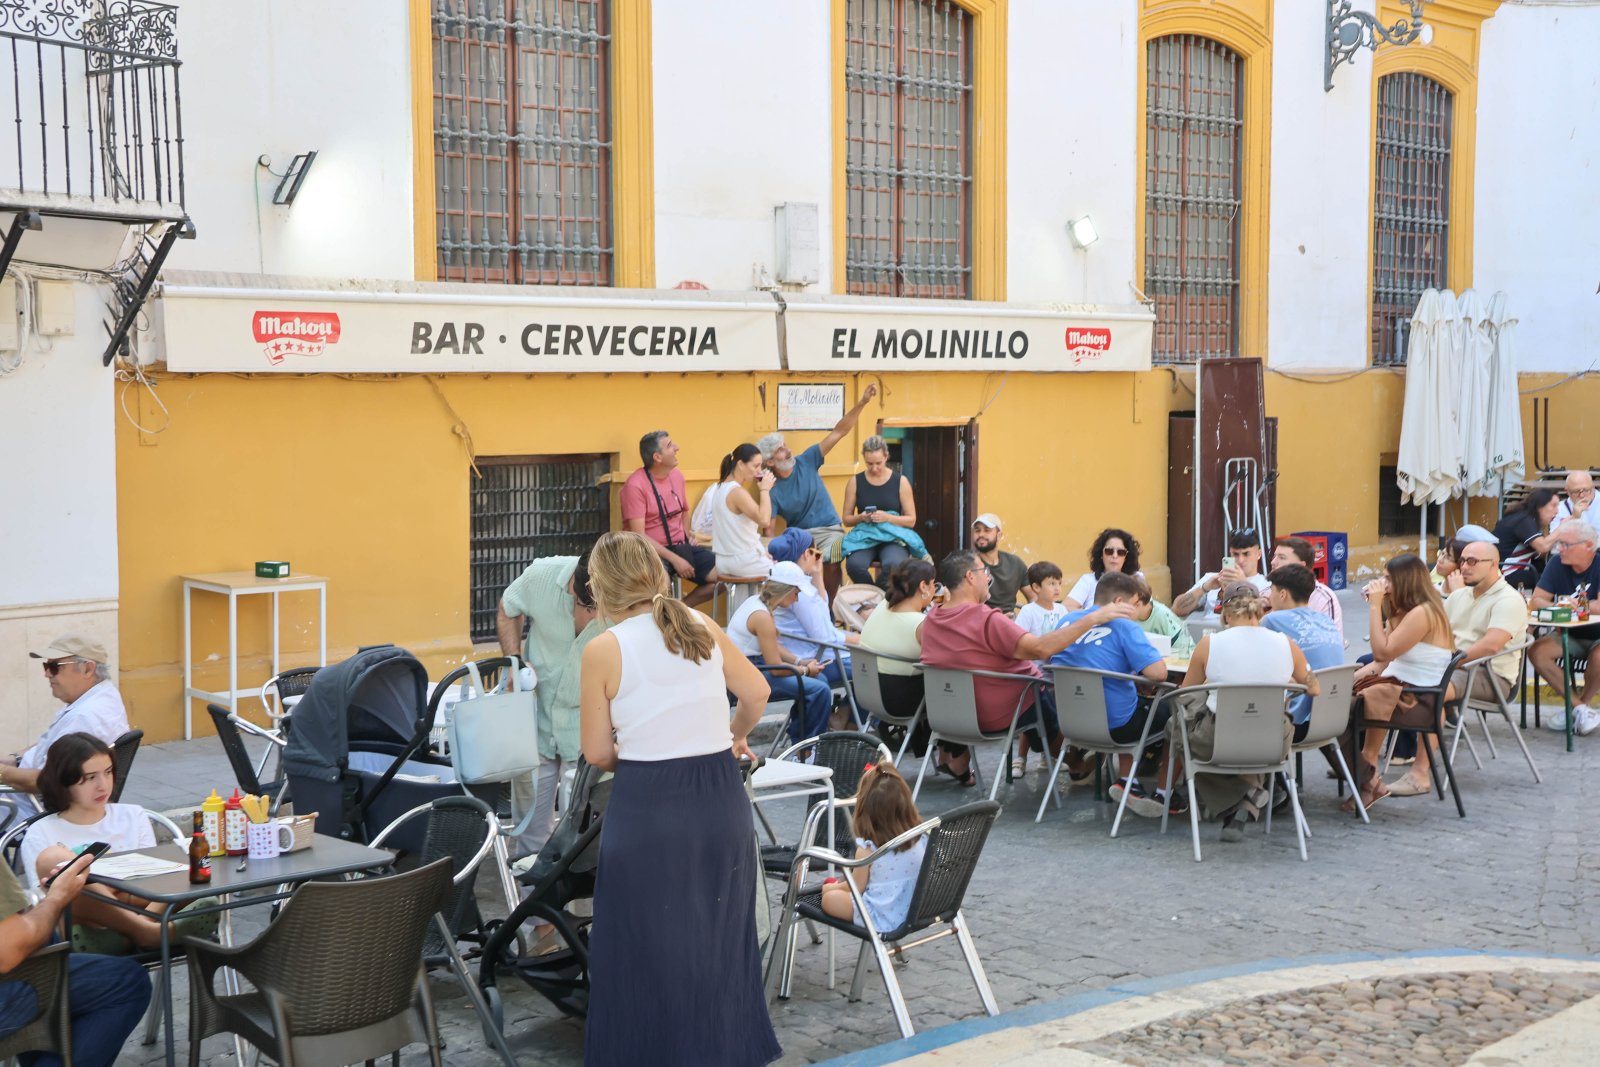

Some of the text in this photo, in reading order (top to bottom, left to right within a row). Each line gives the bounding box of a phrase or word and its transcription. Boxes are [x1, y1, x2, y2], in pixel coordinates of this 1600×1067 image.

[258, 316, 333, 336] Mahou
[410, 322, 720, 356] BAR CERVECERIA
[831, 328, 1029, 360] EL MOLINILLO
[1068, 331, 1107, 345] Mahou
[788, 388, 799, 404] El
